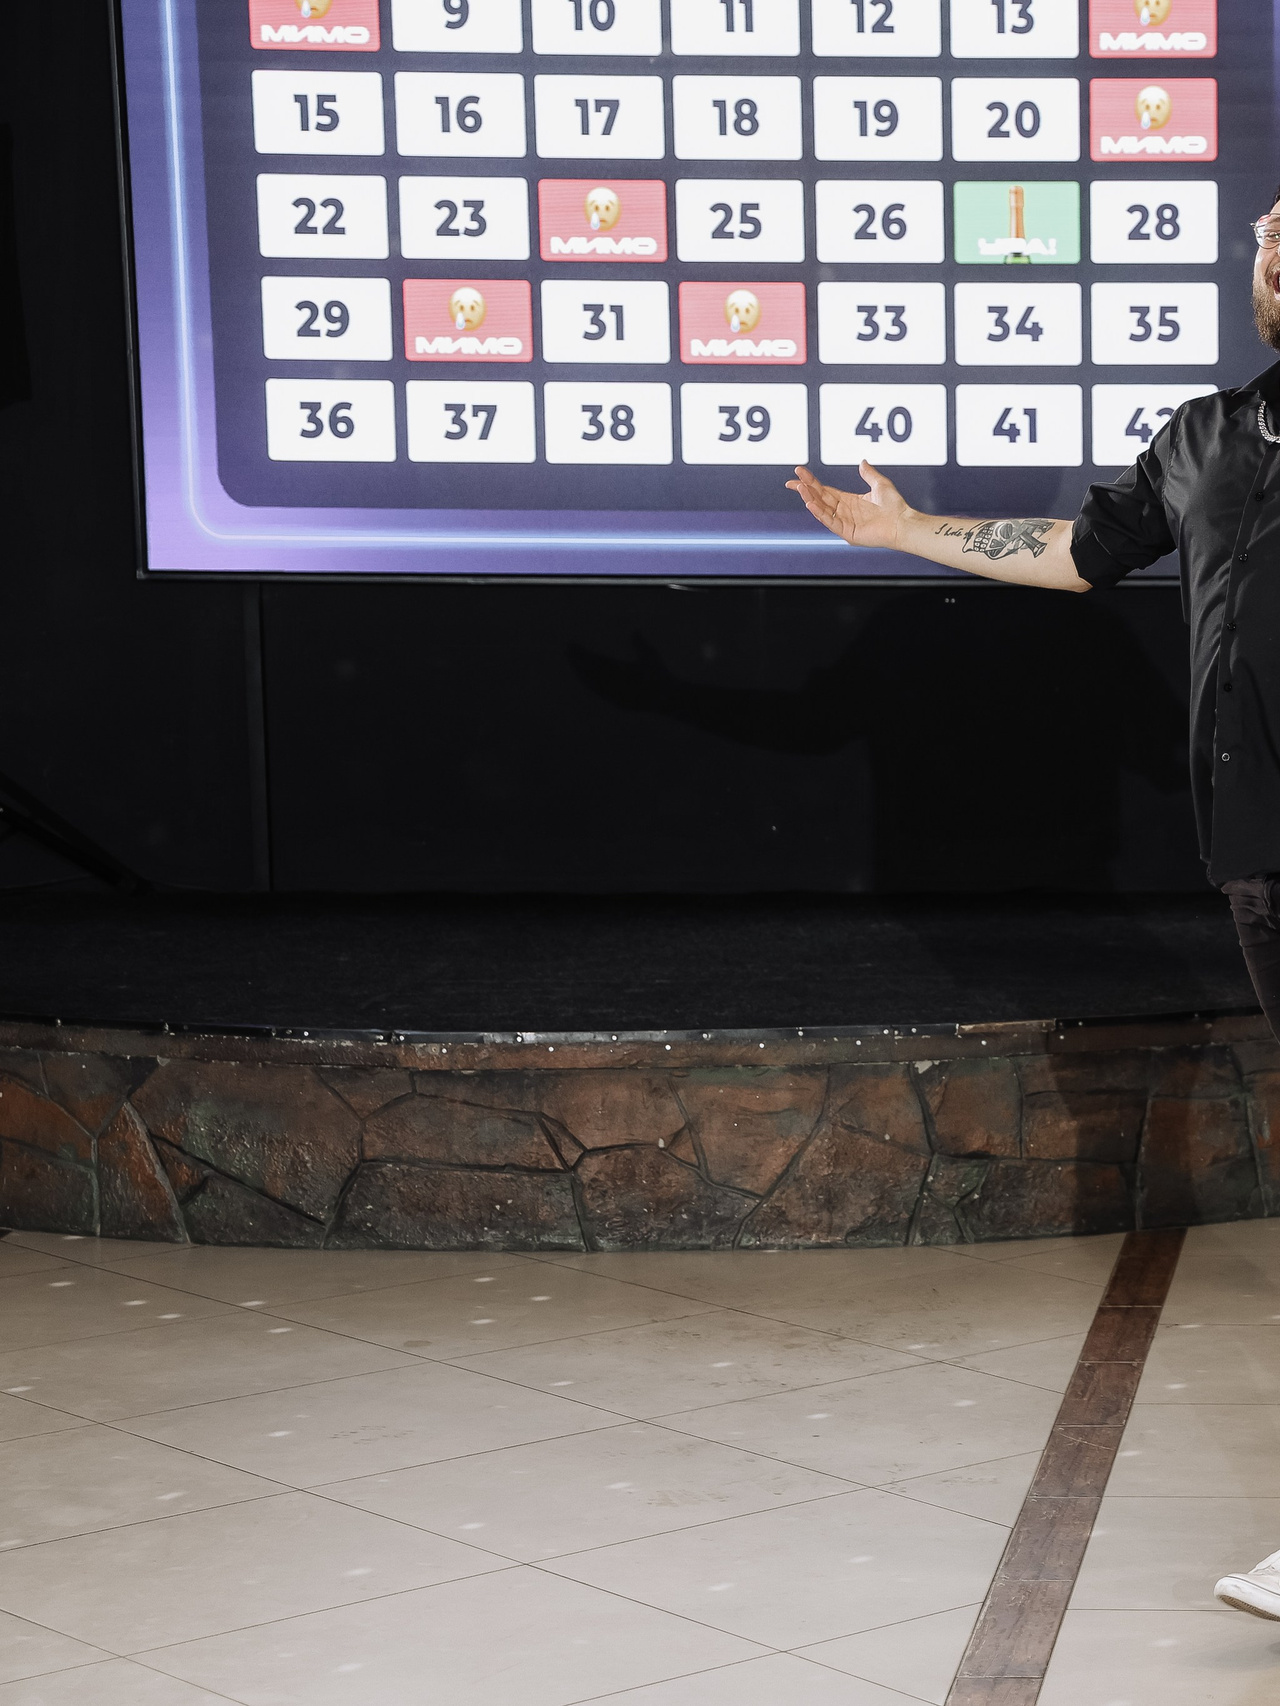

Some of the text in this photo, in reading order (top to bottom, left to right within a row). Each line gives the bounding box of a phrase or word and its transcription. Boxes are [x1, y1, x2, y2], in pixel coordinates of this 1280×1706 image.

[445, 0, 468, 29] 9
[569, 0, 615, 31] 10
[720, 0, 753, 32] 11
[851, 0, 894, 33] 12
[992, 0, 1034, 34] 13
[261, 24, 369, 44] МИМО
[1099, 32, 1206, 51] МИМО
[294, 95, 339, 131] 15
[435, 96, 482, 133] 16
[575, 99, 619, 135] 17
[713, 99, 759, 136] 18
[854, 100, 898, 137] 19
[987, 101, 1040, 138] 20
[1100, 135, 1207, 154] МИМО
[292, 198, 345, 234] 22
[435, 200, 486, 237] 23
[710, 203, 761, 239] 25
[853, 204, 906, 240] 26
[1127, 204, 1180, 240] 28
[550, 236, 657, 255] МИМО
[295, 301, 349, 337] 29
[583, 304, 624, 340] 31
[857, 306, 907, 341] 33
[987, 306, 1043, 341] 34
[1129, 306, 1180, 341] 35
[415, 336, 522, 355] МИМО
[690, 338, 797, 357] МИМО
[300, 402, 354, 438] 36
[445, 404, 497, 440] 37
[582, 405, 635, 441] 38
[719, 406, 770, 442] 39
[856, 407, 912, 442] 40
[993, 408, 1036, 443] 41
